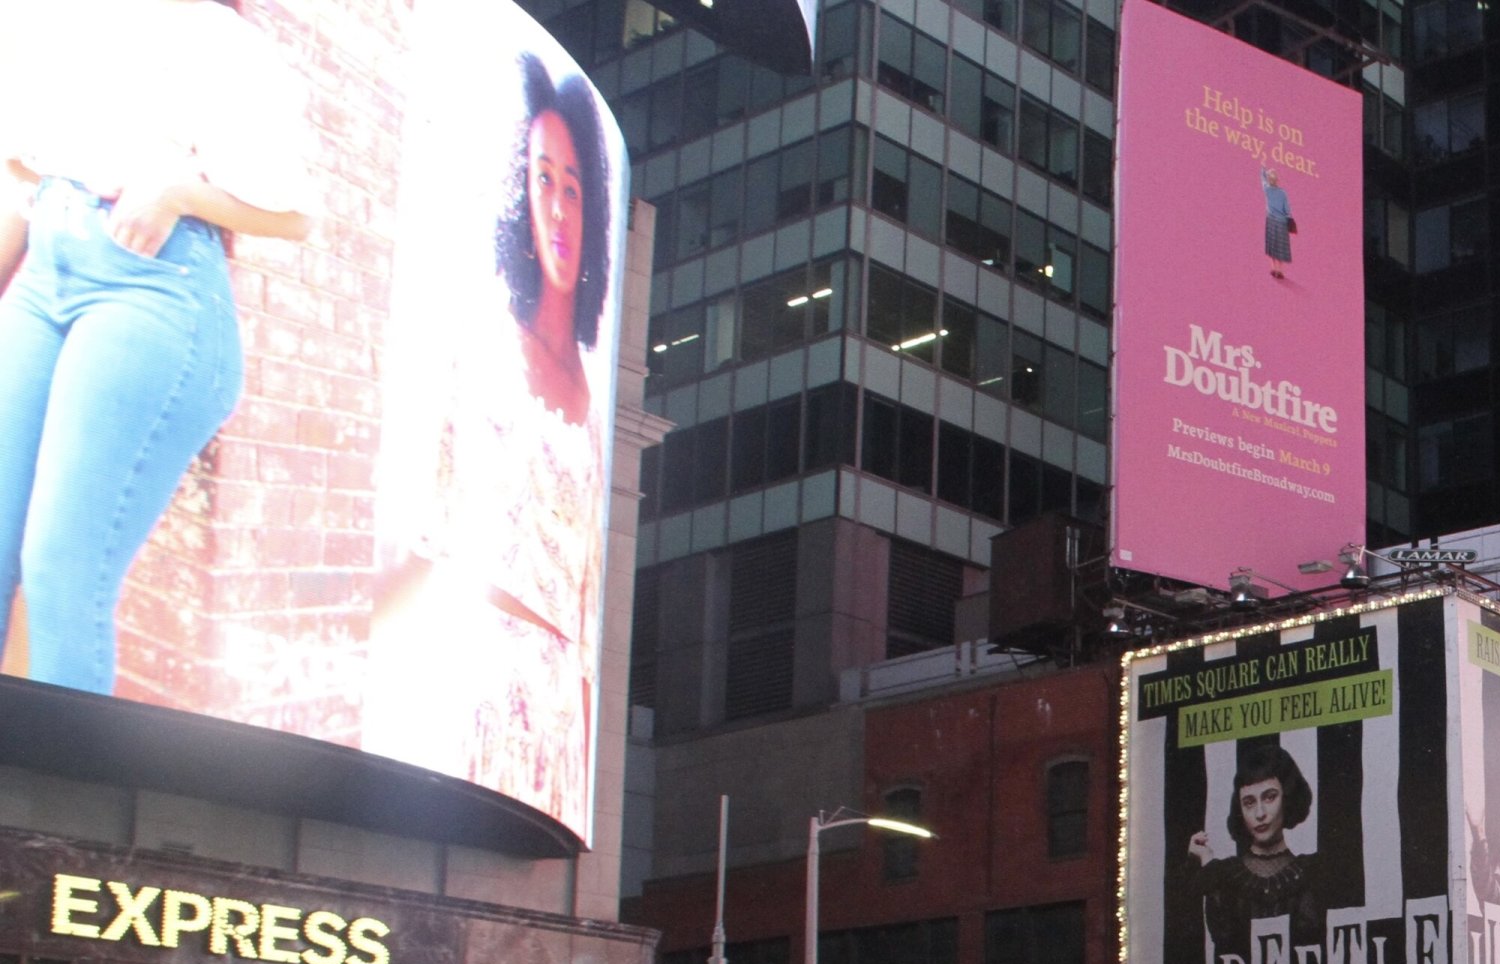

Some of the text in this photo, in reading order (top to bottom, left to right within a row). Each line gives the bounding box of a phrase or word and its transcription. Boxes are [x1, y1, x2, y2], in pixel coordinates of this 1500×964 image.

[1185, 107, 1319, 178] the way, dear.
[1203, 85, 1303, 146] Help is on
[1189, 324, 1262, 371] Mrs.
[1163, 345, 1338, 433] Doubtfire
[1167, 443, 1335, 503] MrsDoubtfireBroadway.com
[1172, 417, 1331, 476] Previews begin March 9
[1144, 634, 1371, 708] TIMES SQUARE CAN REALLY
[1185, 678, 1387, 738] MAKE YOU FEEL ALIVE!
